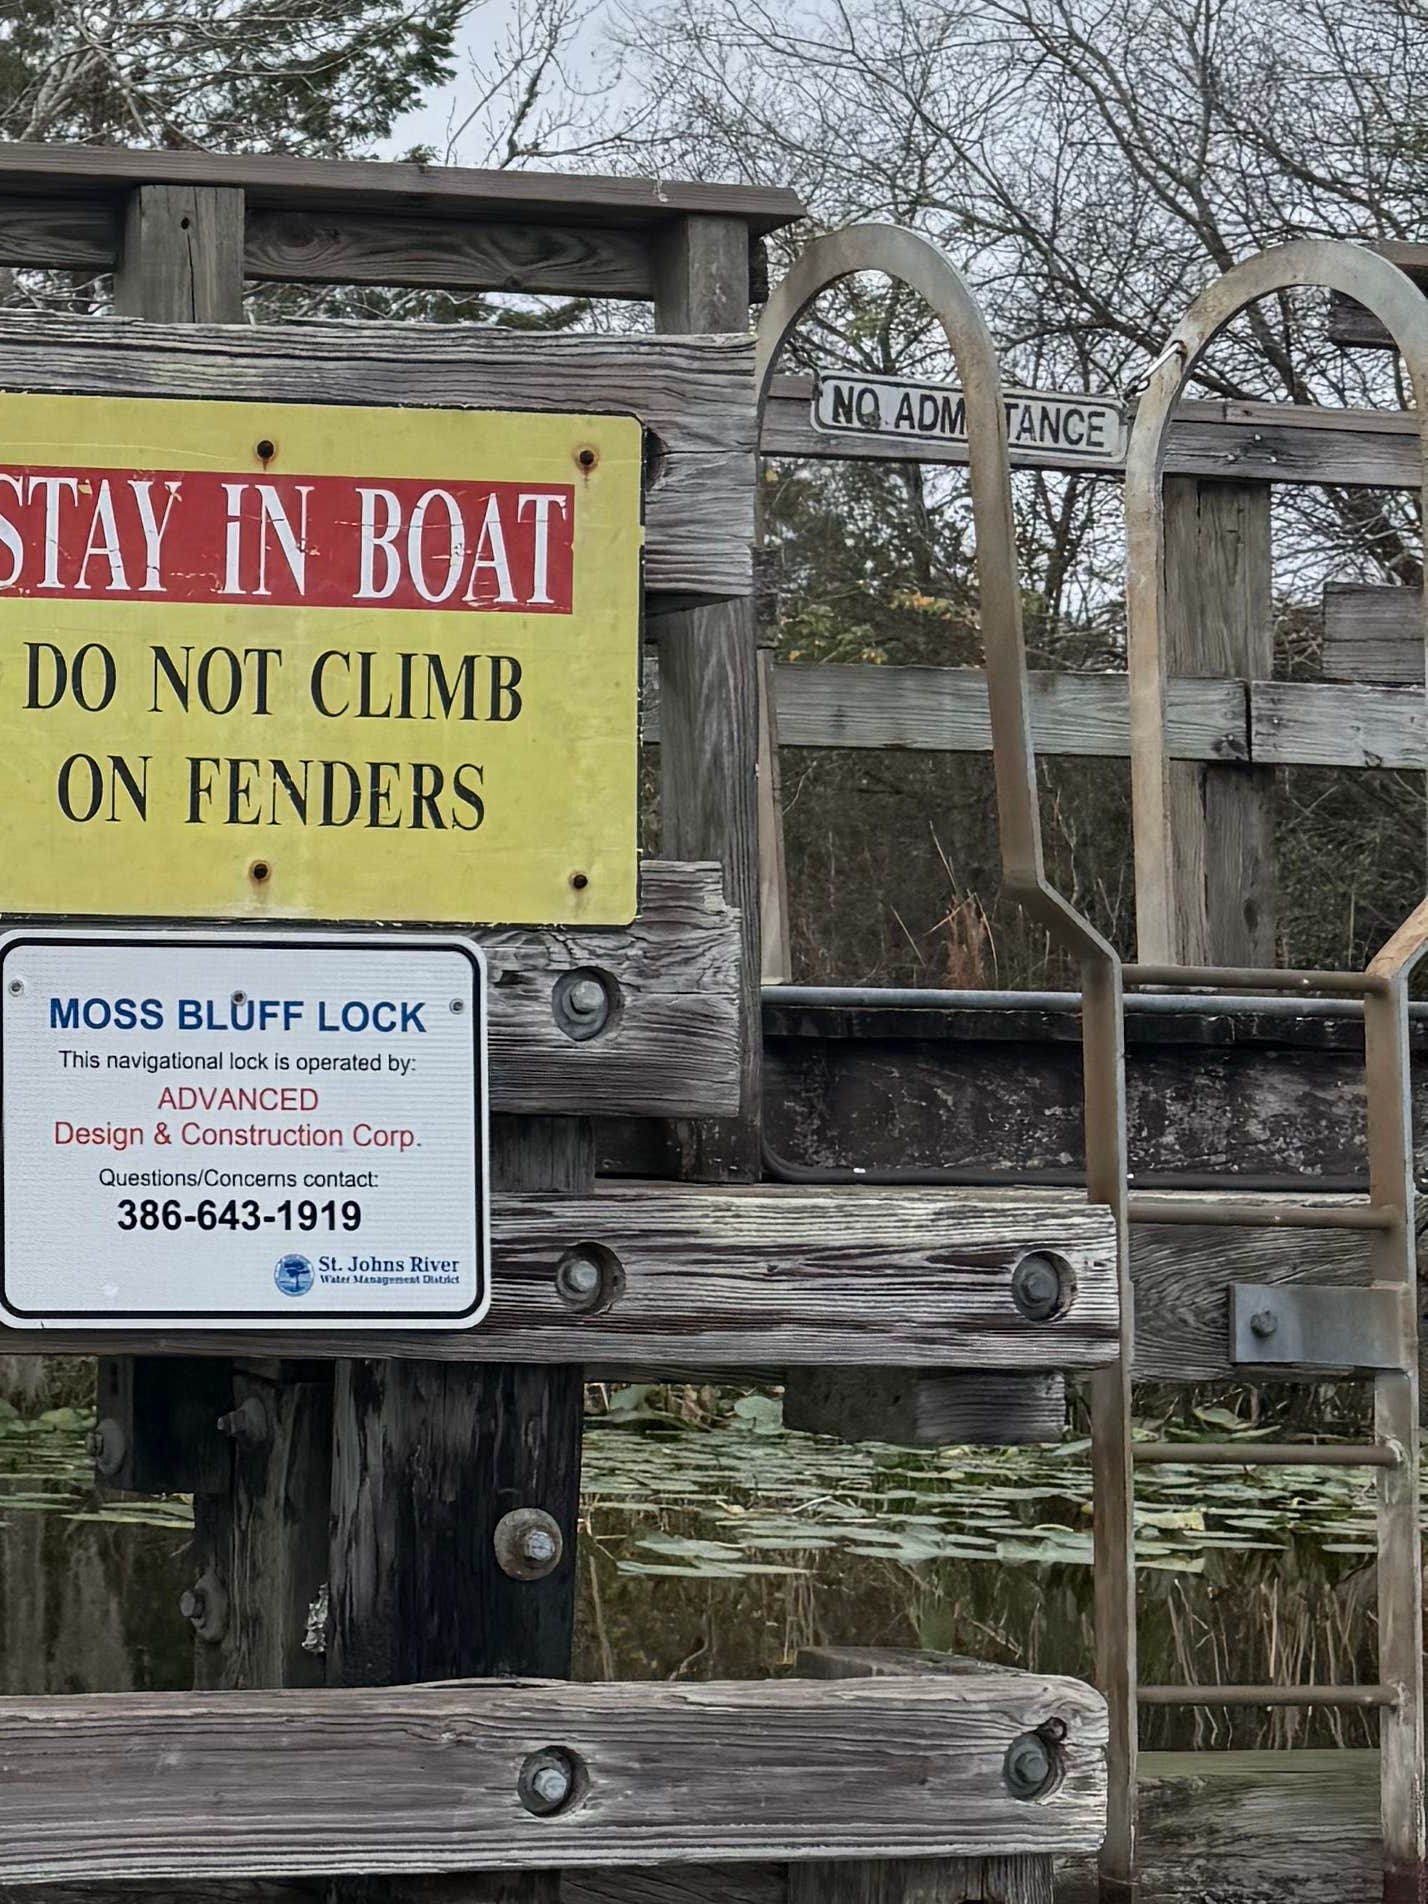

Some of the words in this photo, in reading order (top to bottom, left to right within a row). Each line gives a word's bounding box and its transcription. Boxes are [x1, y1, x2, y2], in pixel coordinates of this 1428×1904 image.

[832, 385, 880, 429] NO
[894, 392, 1106, 447] ADMTANCE
[224, 483, 310, 597] IN
[353, 488, 567, 604] BOAT
[23, 642, 117, 713] DO
[150, 646, 282, 717] NOT
[310, 652, 524, 722] CLIMB
[55, 753, 150, 823] ON
[184, 757, 487, 831] FENDERS
[50, 998, 164, 1029] MOSS
[178, 1000, 304, 1031] BLUFF
[319, 1001, 426, 1032] LOCK
[59, 1050, 100, 1069] This
[107, 1051, 222, 1073] navigational
[230, 1052, 268, 1070] lock
[274, 1053, 289, 1070] is
[296, 1054, 381, 1074] operated
[388, 1054, 416, 1075] by:
[158, 1087, 319, 1111] ADVANCED
[55, 1121, 143, 1150] Design
[154, 1122, 172, 1145] &
[181, 1122, 343, 1147] Construction
[353, 1123, 421, 1152] Corp.
[99, 1168, 296, 1188] Questions/Concerns
[303, 1171, 379, 1187] contact:
[117, 1199, 362, 1231] 386-643-1919
[318, 1256, 342, 1272] St.
[348, 1256, 405, 1272] Johns
[410, 1257, 459, 1272] River
[320, 1274, 350, 1284] Water
[354, 1275, 420, 1286] Management
[423, 1275, 459, 1284] District
